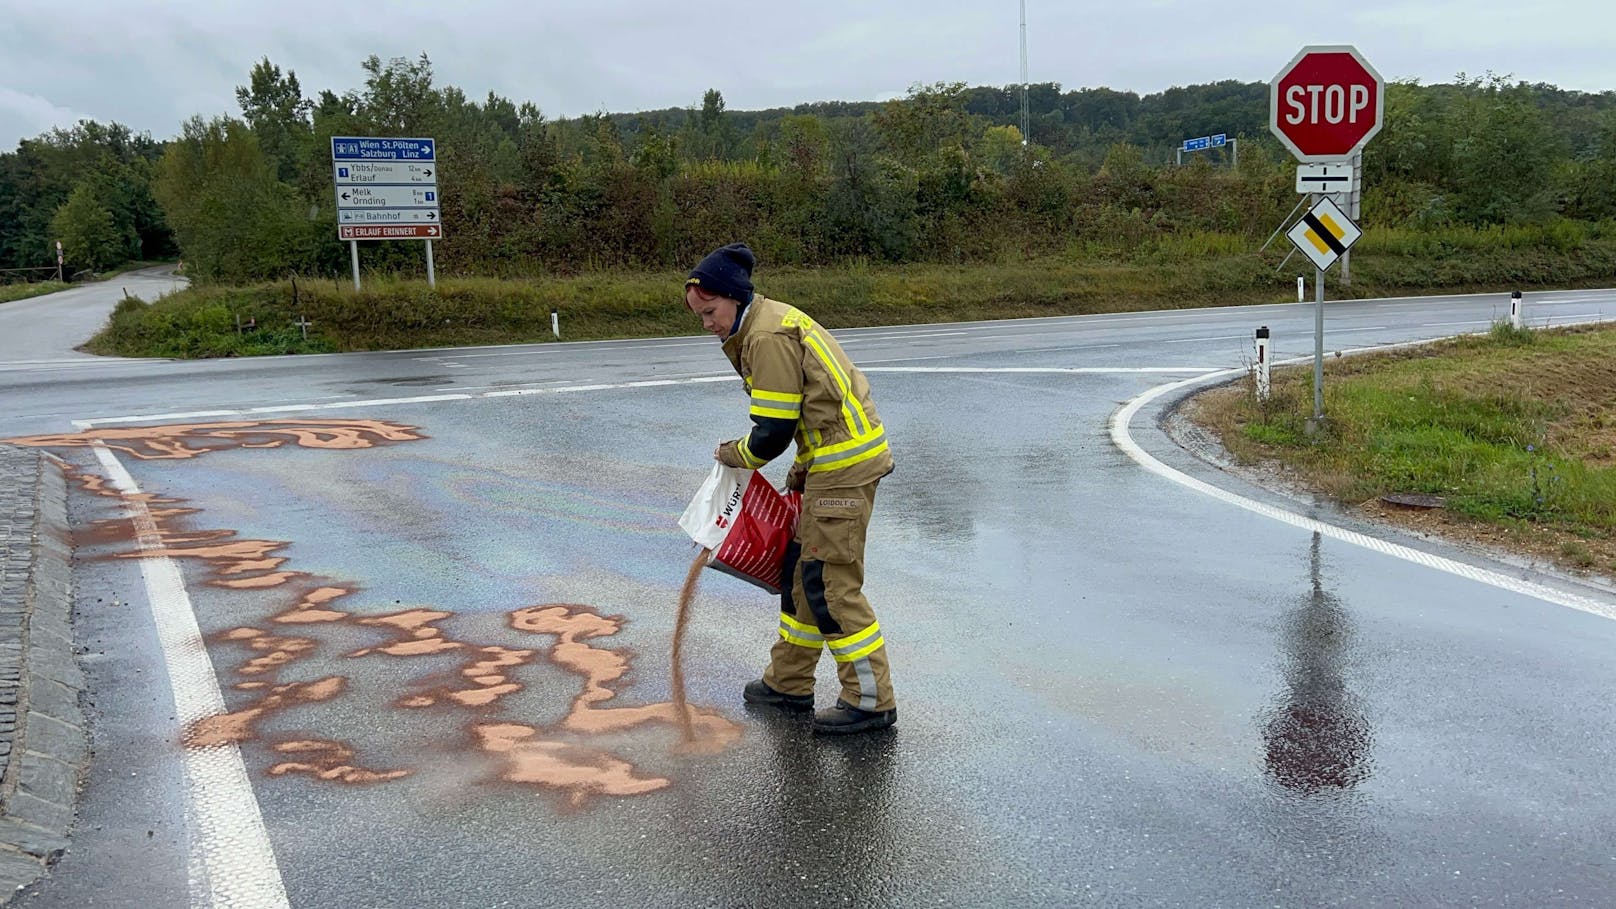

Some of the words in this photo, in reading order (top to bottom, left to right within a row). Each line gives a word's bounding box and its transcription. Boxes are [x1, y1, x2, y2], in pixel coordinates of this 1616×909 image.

[1286, 84, 1369, 125] STOP
[349, 145, 358, 153] A1
[359, 140, 380, 149] Wien
[360, 149, 397, 159] Salzburg
[402, 150, 420, 158] Linz
[351, 174, 376, 182] Erlauf
[352, 188, 372, 196] Melk
[353, 197, 386, 206] Ornding
[366, 212, 400, 220] Bahnhof
[355, 227, 382, 236] ERLAUF
[384, 227, 417, 236] ERINNERT
